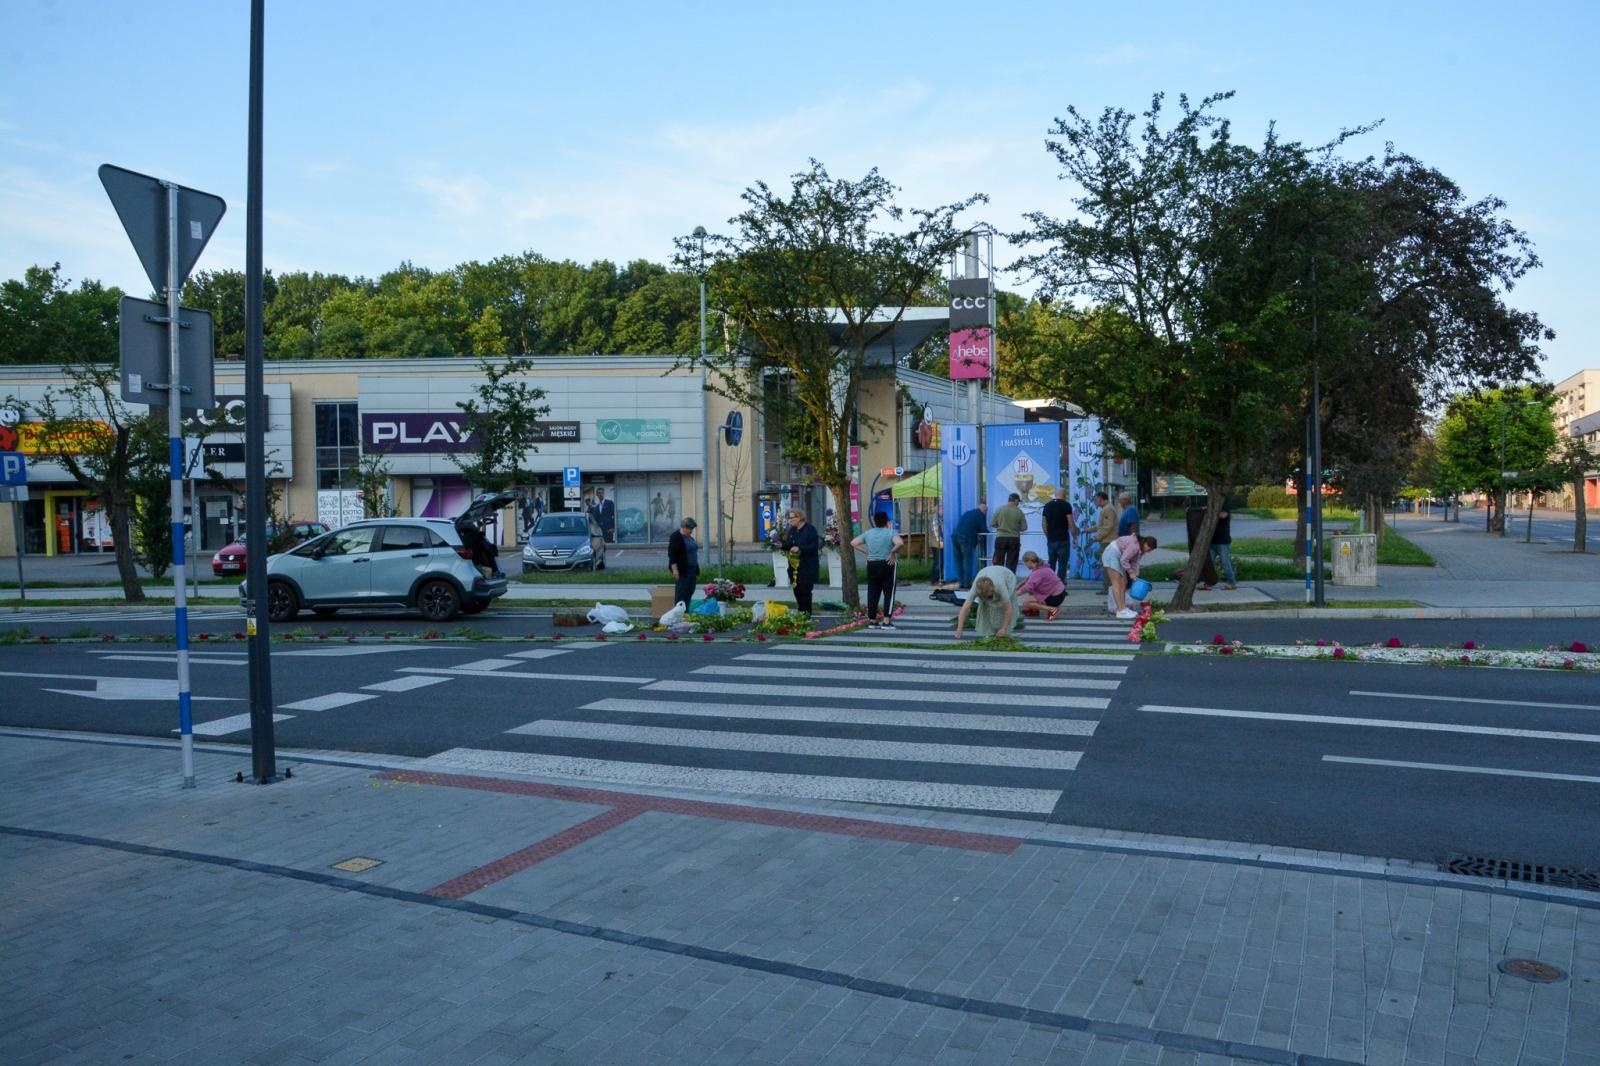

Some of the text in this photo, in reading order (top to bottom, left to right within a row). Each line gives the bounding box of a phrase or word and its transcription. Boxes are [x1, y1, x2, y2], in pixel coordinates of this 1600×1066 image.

[958, 344, 988, 357] hebe
[372, 421, 474, 444] PLAY
[1013, 428, 1031, 436] JEDLI
[1004, 438, 1033, 447] NASYCILI
[1034, 437, 1045, 447] SIĘ
[952, 445, 966, 460] IHS
[3, 455, 20, 481] P
[567, 468, 577, 481] P
